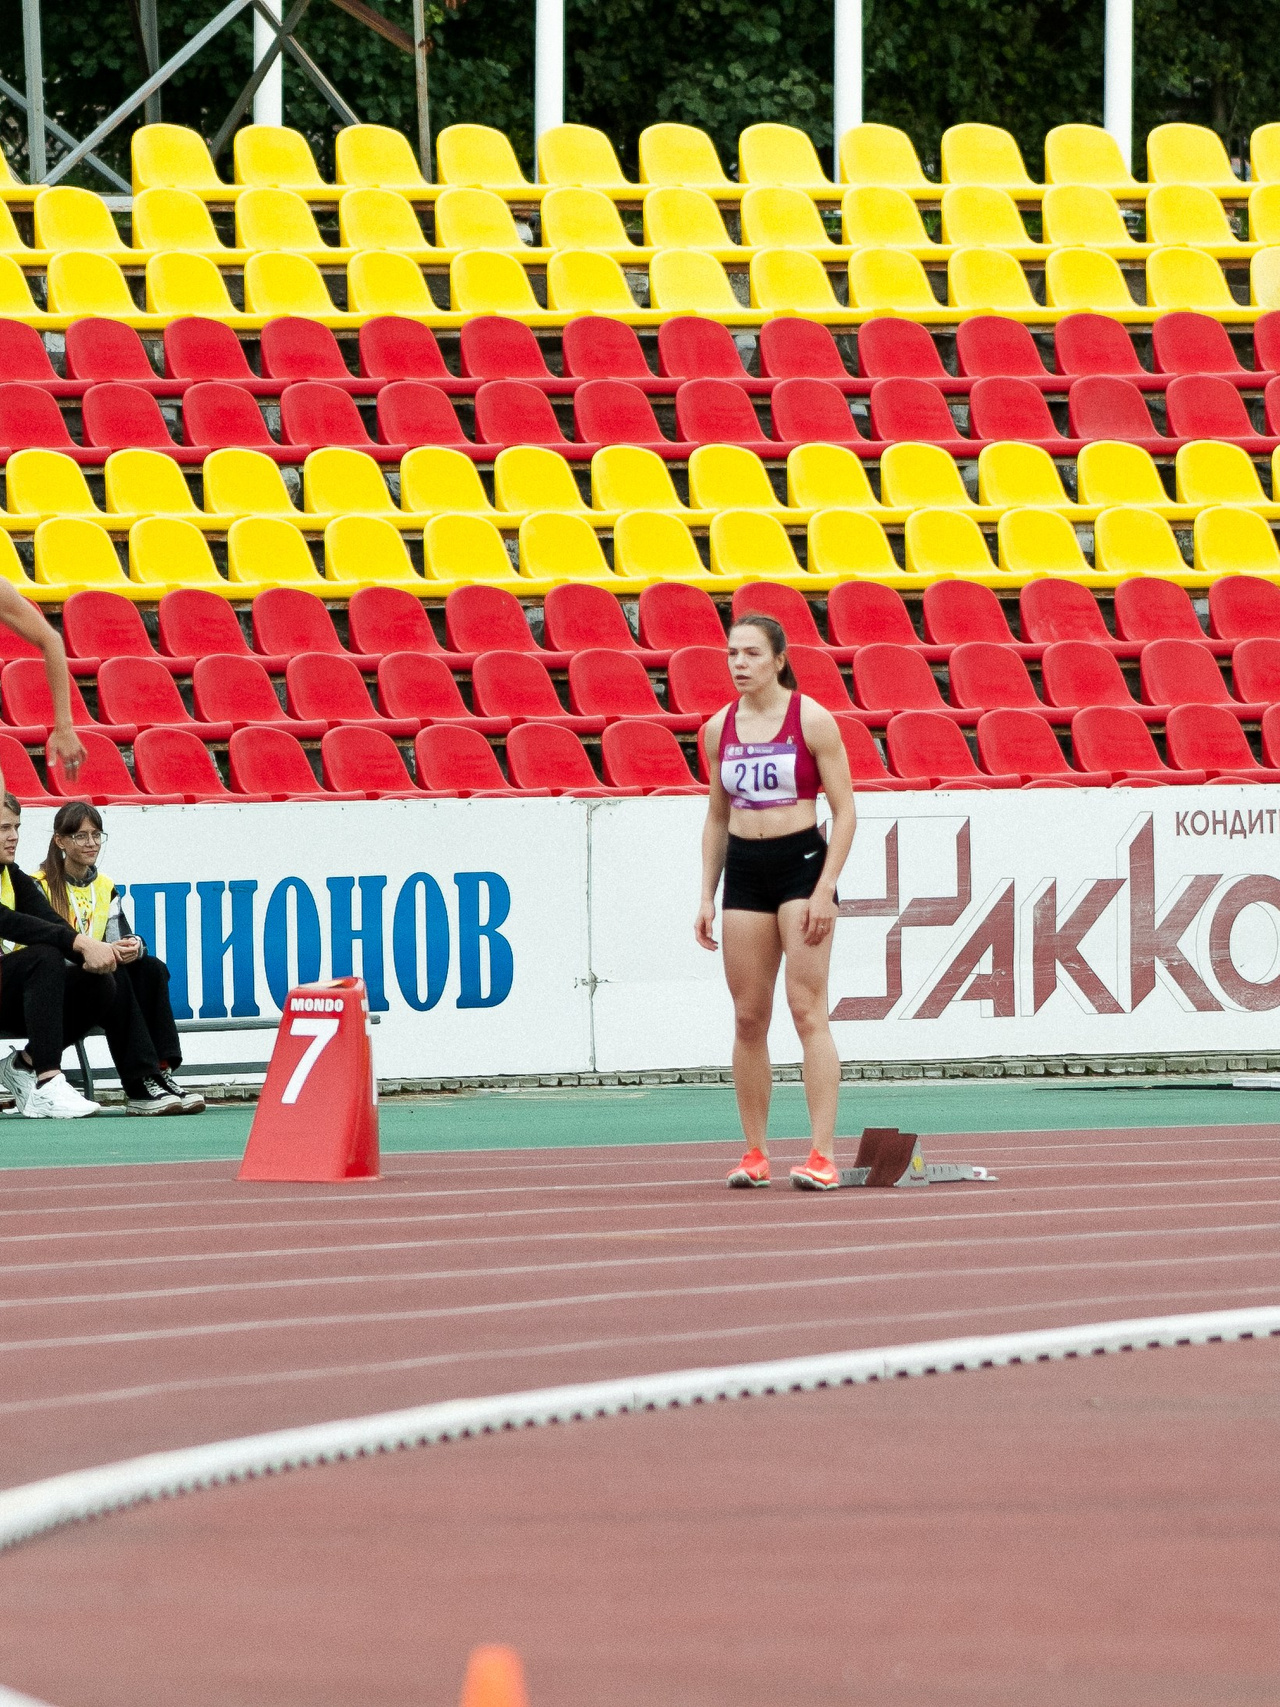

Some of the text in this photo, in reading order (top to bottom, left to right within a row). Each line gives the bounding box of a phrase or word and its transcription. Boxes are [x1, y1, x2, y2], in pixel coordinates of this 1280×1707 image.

[734, 762, 779, 792] 216
[1175, 809, 1280, 840] КОНДИТ
[115, 871, 514, 1020] ПИОНОВ
[290, 998, 344, 1012] MONDO
[281, 1018, 340, 1104] 7
